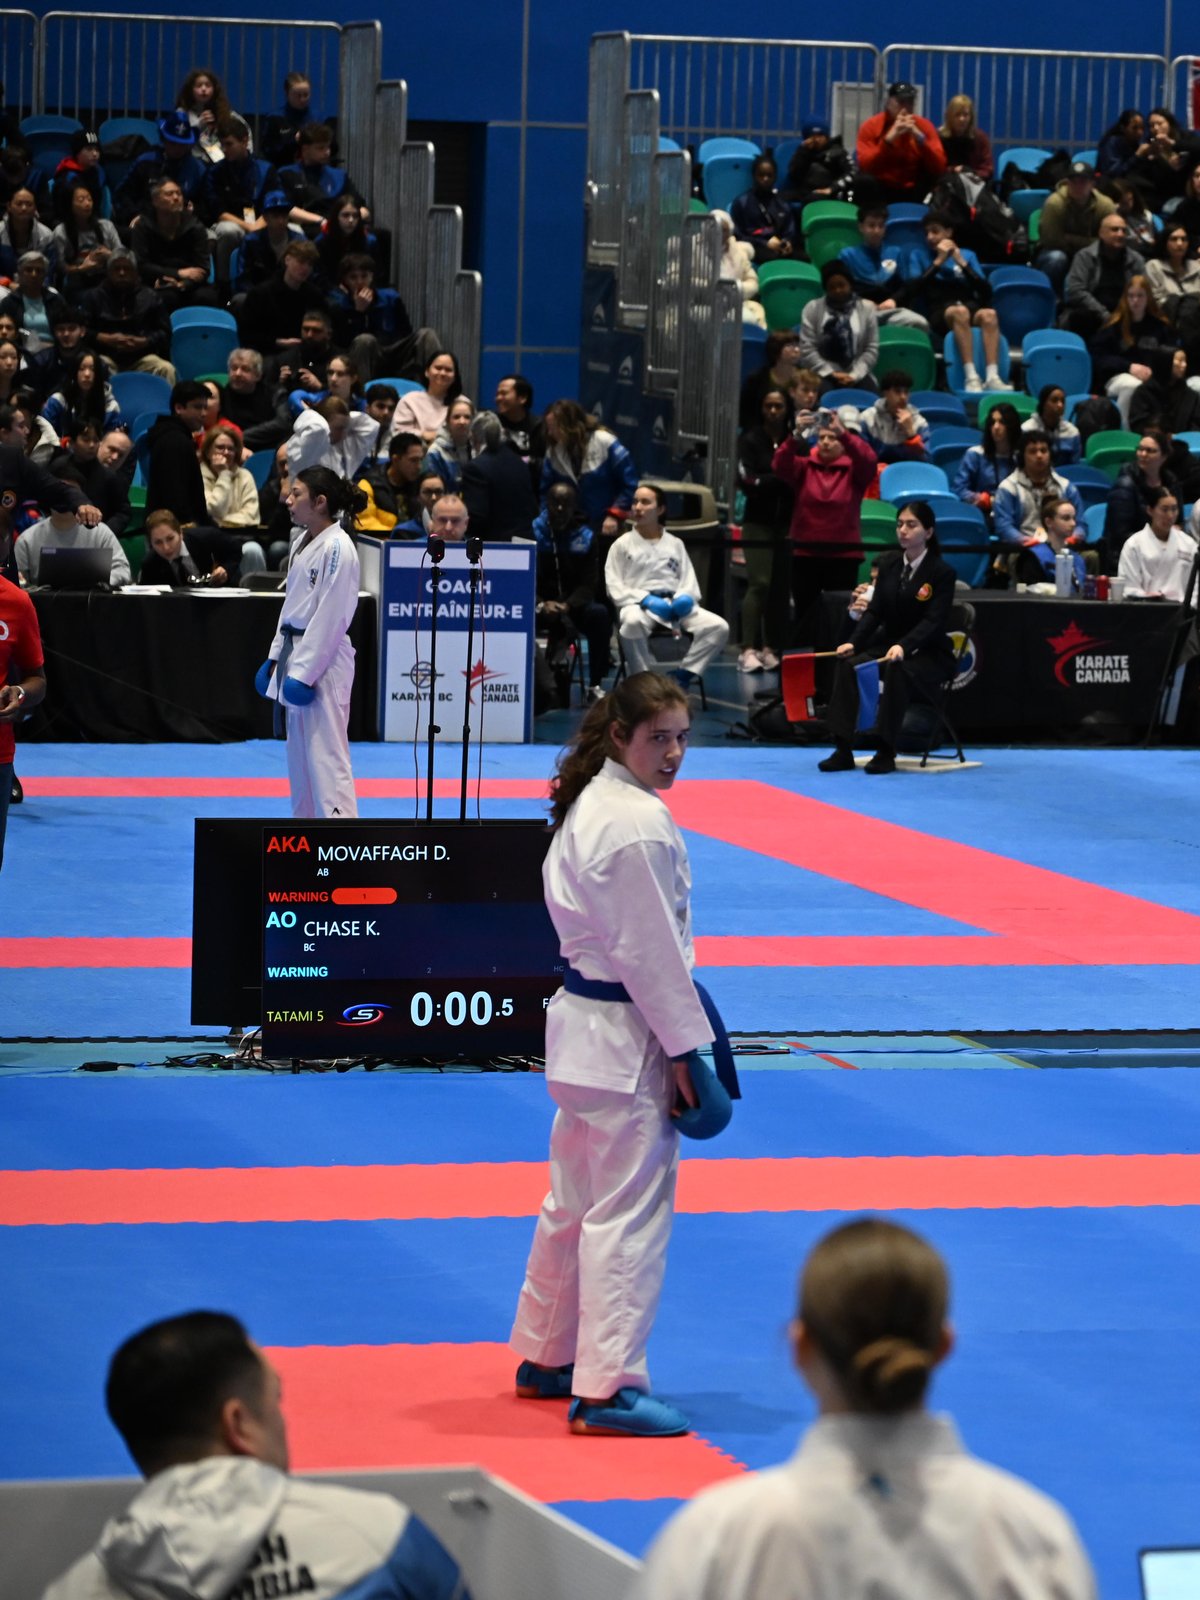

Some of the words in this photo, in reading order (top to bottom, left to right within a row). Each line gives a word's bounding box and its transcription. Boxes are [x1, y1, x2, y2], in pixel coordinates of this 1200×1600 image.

[425, 579, 491, 594] COACH
[1076, 655, 1129, 669] KARATE
[1076, 669, 1130, 683] CANADA
[482, 684, 519, 693] KARATE
[391, 692, 431, 701] KARAT
[438, 693, 453, 701] BC
[482, 693, 519, 703] CANADA
[266, 836, 311, 853] AKA
[318, 846, 428, 862] MOVAFFAGH
[434, 845, 450, 861] D.
[316, 868, 330, 877] AB
[268, 892, 329, 902] WARNING
[266, 911, 297, 928] AO
[304, 921, 360, 937] CHASE
[366, 921, 380, 936] K.
[304, 943, 315, 952] BC
[267, 966, 328, 978] WARNING
[267, 1010, 313, 1022] TATAMI
[317, 1010, 324, 1022] 5
